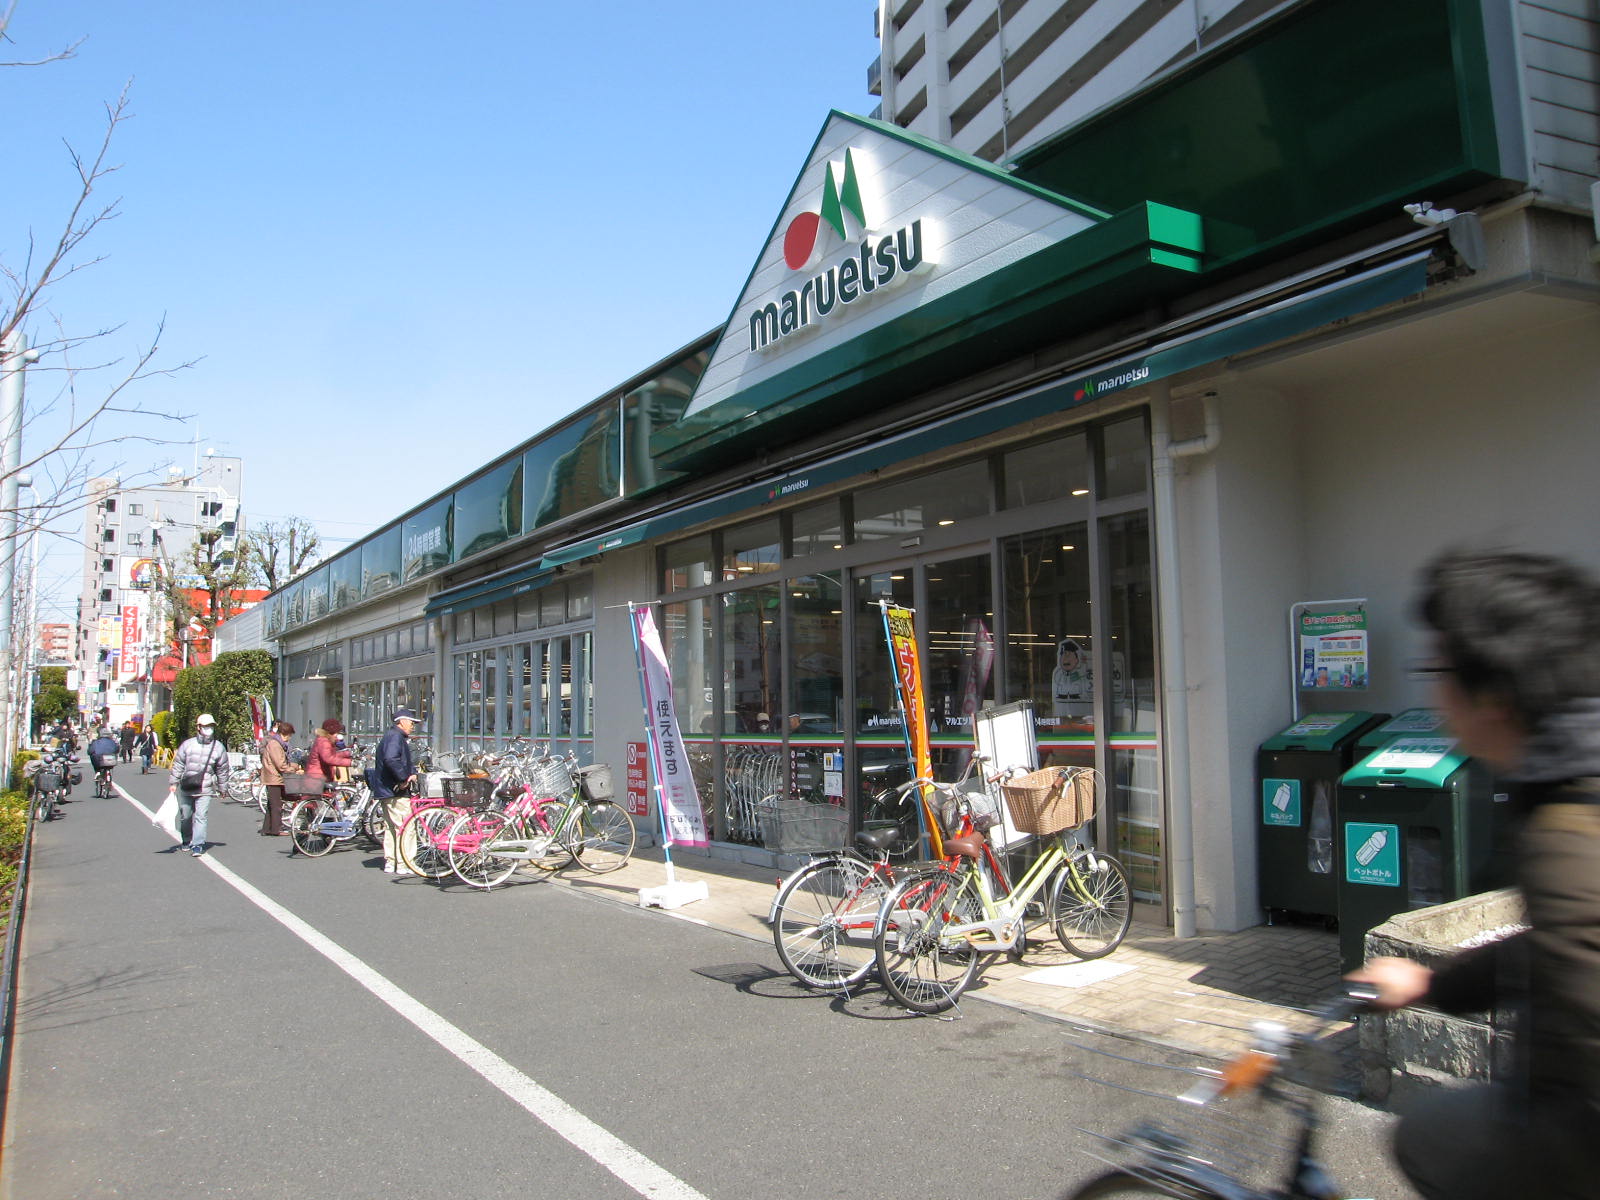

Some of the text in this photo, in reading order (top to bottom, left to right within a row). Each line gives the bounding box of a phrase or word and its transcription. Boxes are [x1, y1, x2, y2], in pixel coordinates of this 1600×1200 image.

[750, 217, 923, 352] maruetsu
[1097, 366, 1149, 393] maruetsu
[781, 478, 809, 494] maruetsu
[657, 700, 678, 775] 使えます
[1353, 867, 1392, 878] ペットボトル
